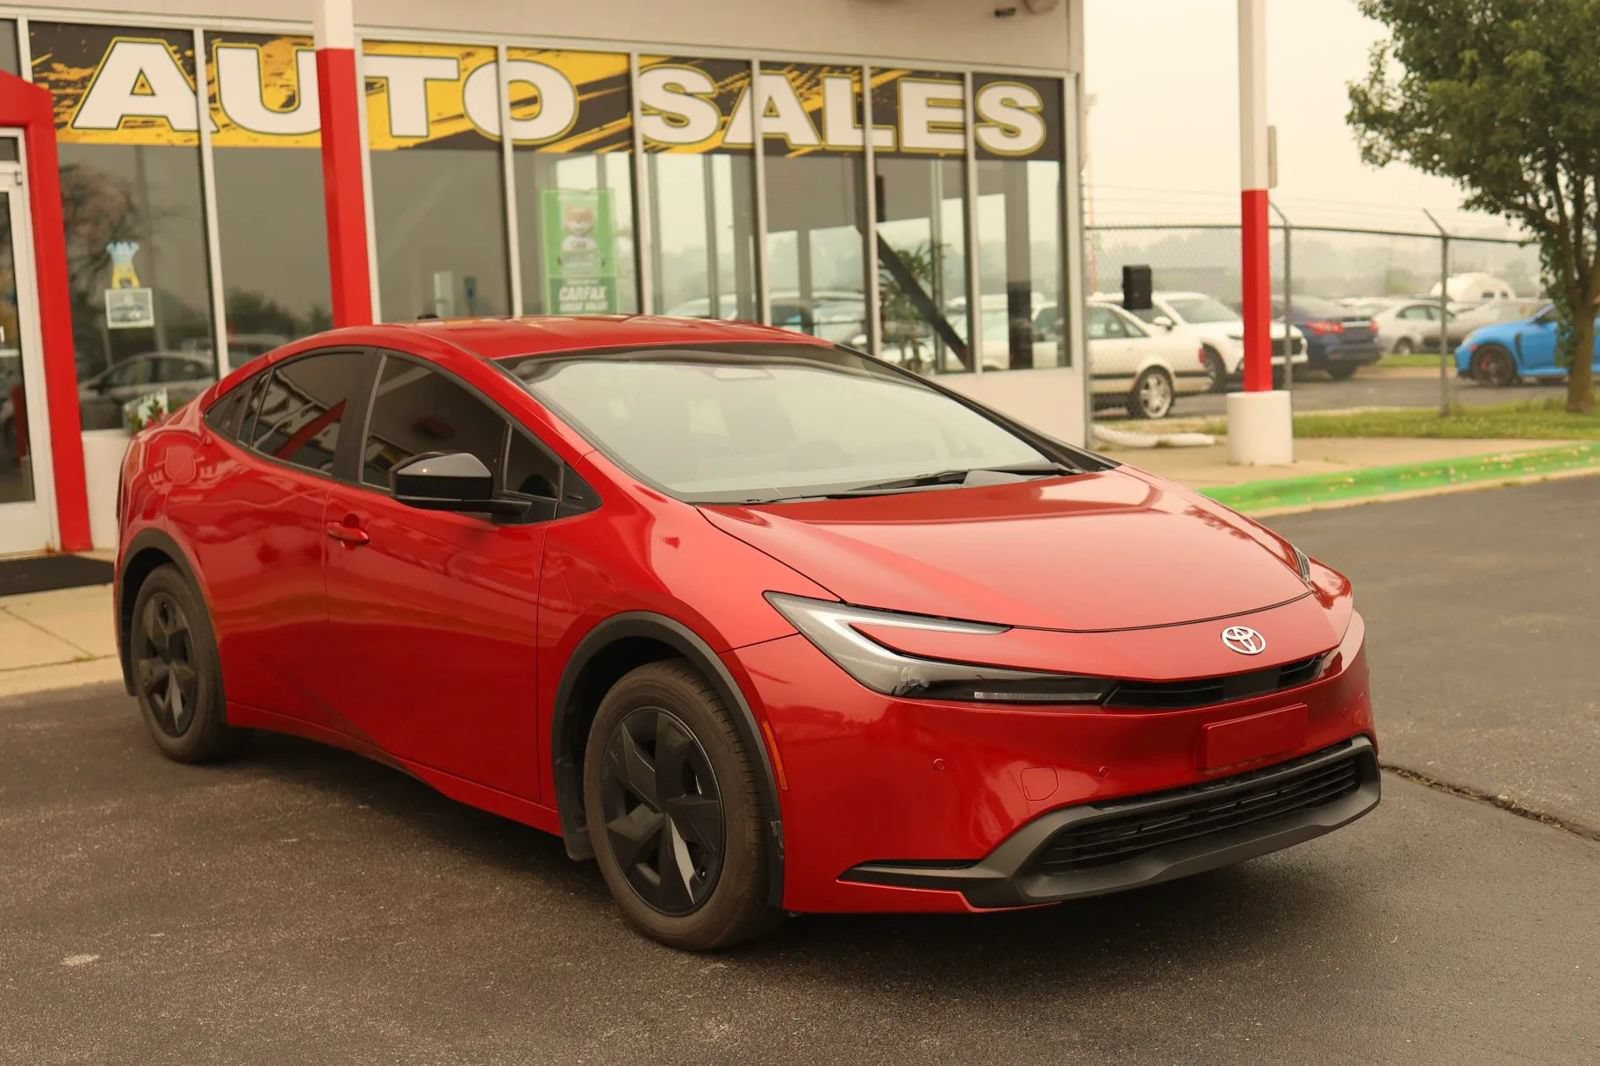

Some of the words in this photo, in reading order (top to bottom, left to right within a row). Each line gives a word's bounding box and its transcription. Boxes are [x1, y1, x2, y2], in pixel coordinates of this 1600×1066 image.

[69, 37, 579, 145] AUTO
[637, 63, 1046, 156] SALES
[559, 286, 607, 301] CARFAX
